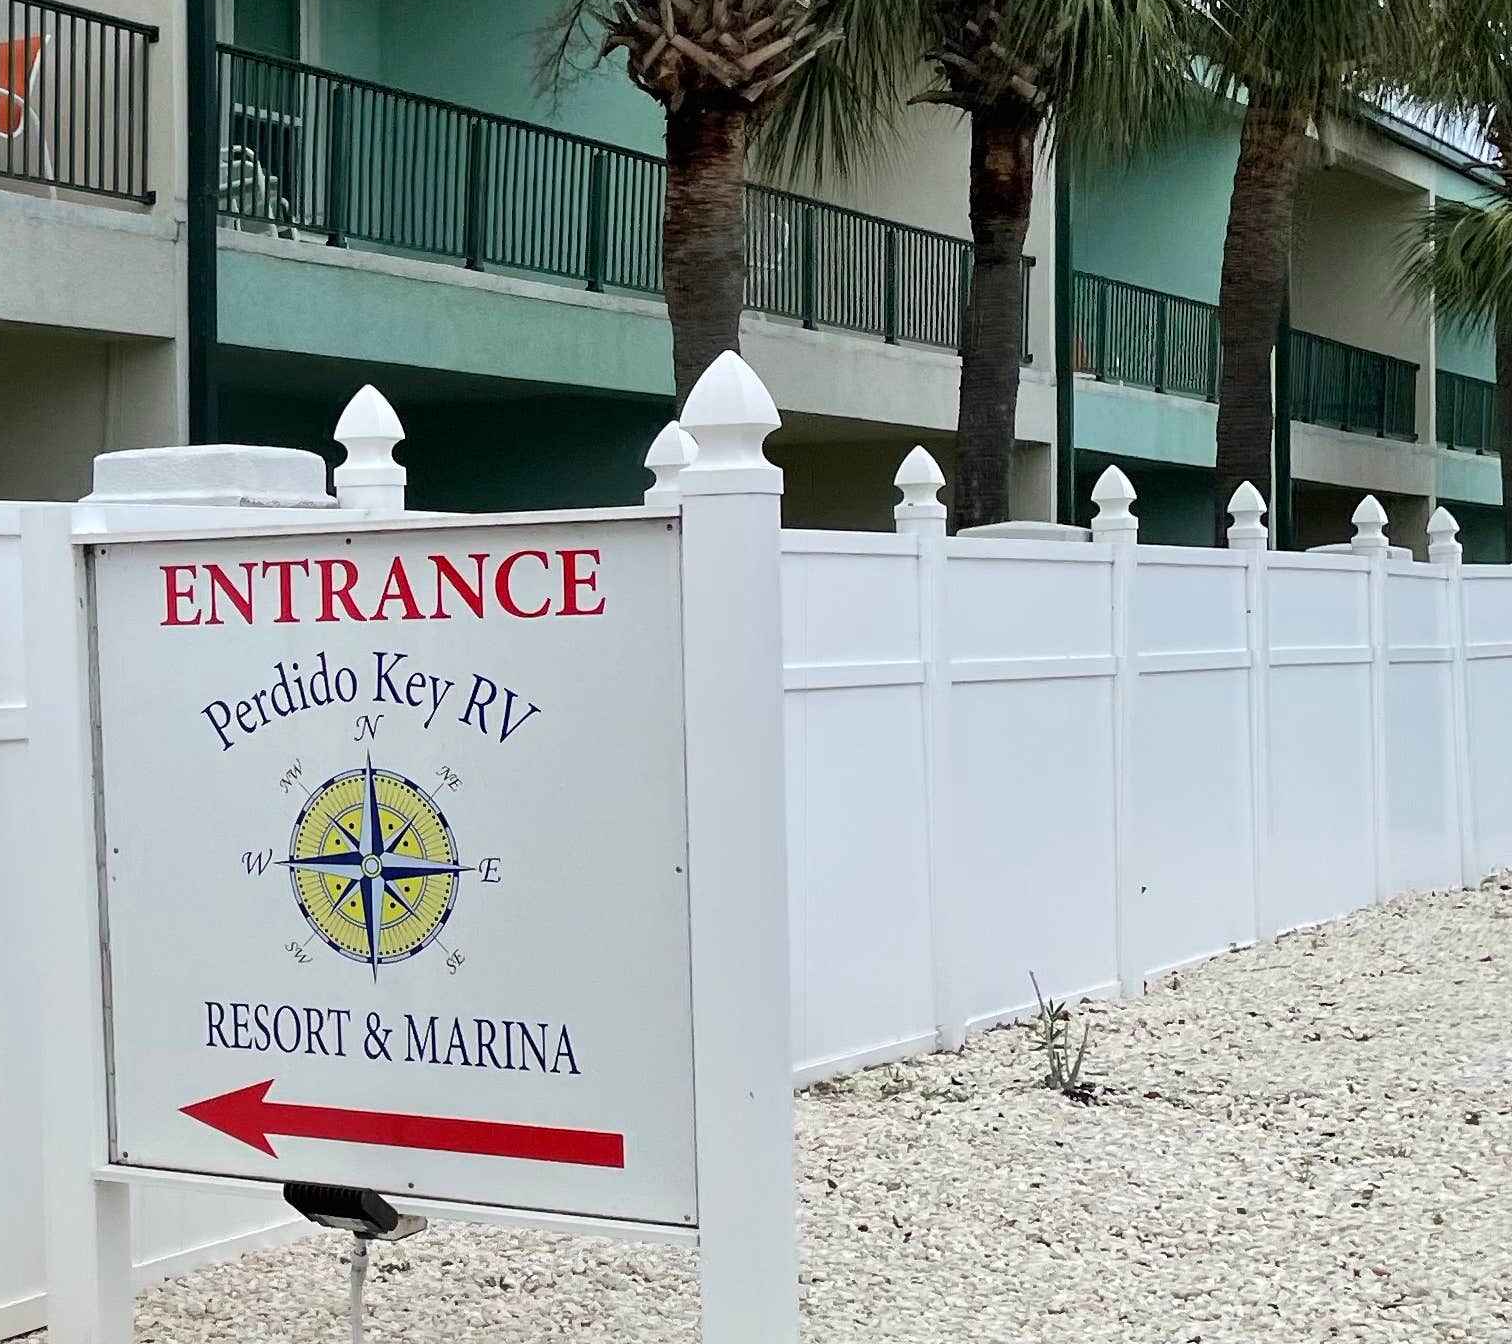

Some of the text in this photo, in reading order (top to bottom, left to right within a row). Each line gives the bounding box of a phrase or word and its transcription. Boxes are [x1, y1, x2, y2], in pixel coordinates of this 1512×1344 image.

[159, 548, 606, 626] ENTRANCE
[201, 651, 542, 751] Perdido Key RV
[353, 714, 385, 742] N
[279, 758, 304, 793] NW
[436, 765, 463, 793] NE
[241, 848, 274, 876] W
[479, 858, 502, 884] E
[285, 940, 313, 964] SW
[445, 948, 466, 975] SE
[205, 1002, 581, 1074] RESORT & MARINA
